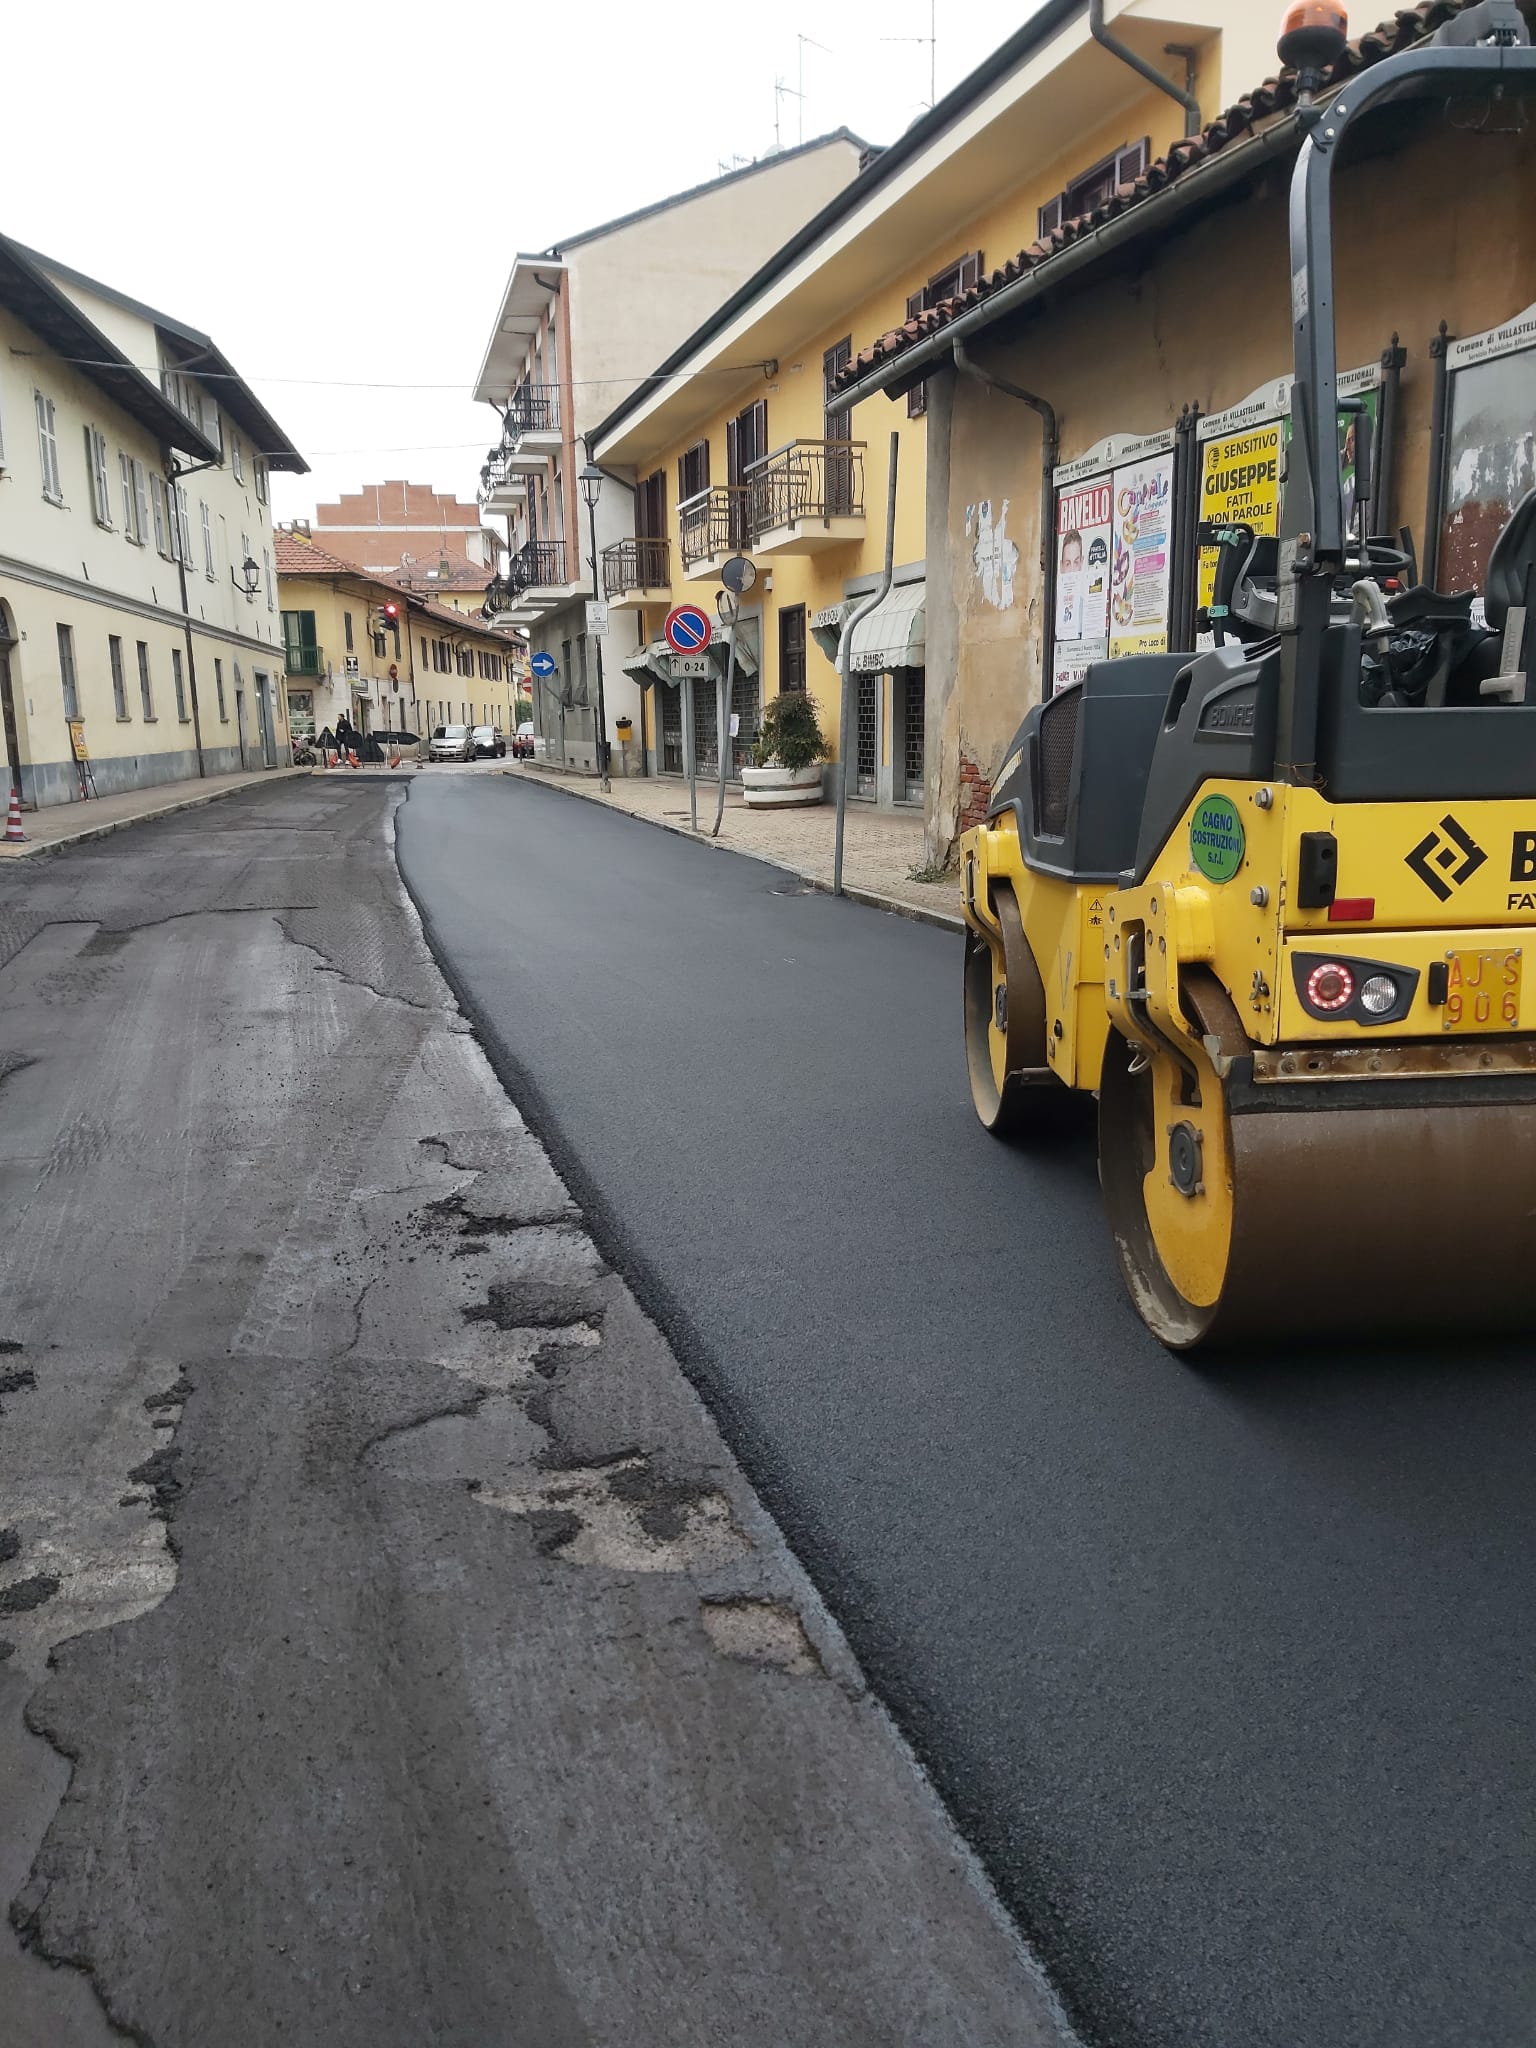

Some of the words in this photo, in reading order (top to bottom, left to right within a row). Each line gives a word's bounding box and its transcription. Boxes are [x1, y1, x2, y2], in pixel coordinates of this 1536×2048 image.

[1456, 339, 1484, 354] Comune
[1487, 332, 1495, 345] di
[1202, 418, 1221, 429] Comune
[1229, 401, 1266, 419] VILLASTELLONE
[1224, 432, 1278, 460] SENSITIVO
[1205, 458, 1276, 496] GIUSEPPE
[1061, 487, 1110, 533] RAVELLO
[1226, 491, 1253, 509] FATTI
[1206, 510, 1230, 524] NON
[1232, 502, 1272, 521] PAROLE
[862, 652, 885, 668] BIMBO
[1202, 811, 1233, 833] CAGNO
[1192, 829, 1241, 853] COSTRUZIONI
[1447, 992, 1517, 1024] 906
